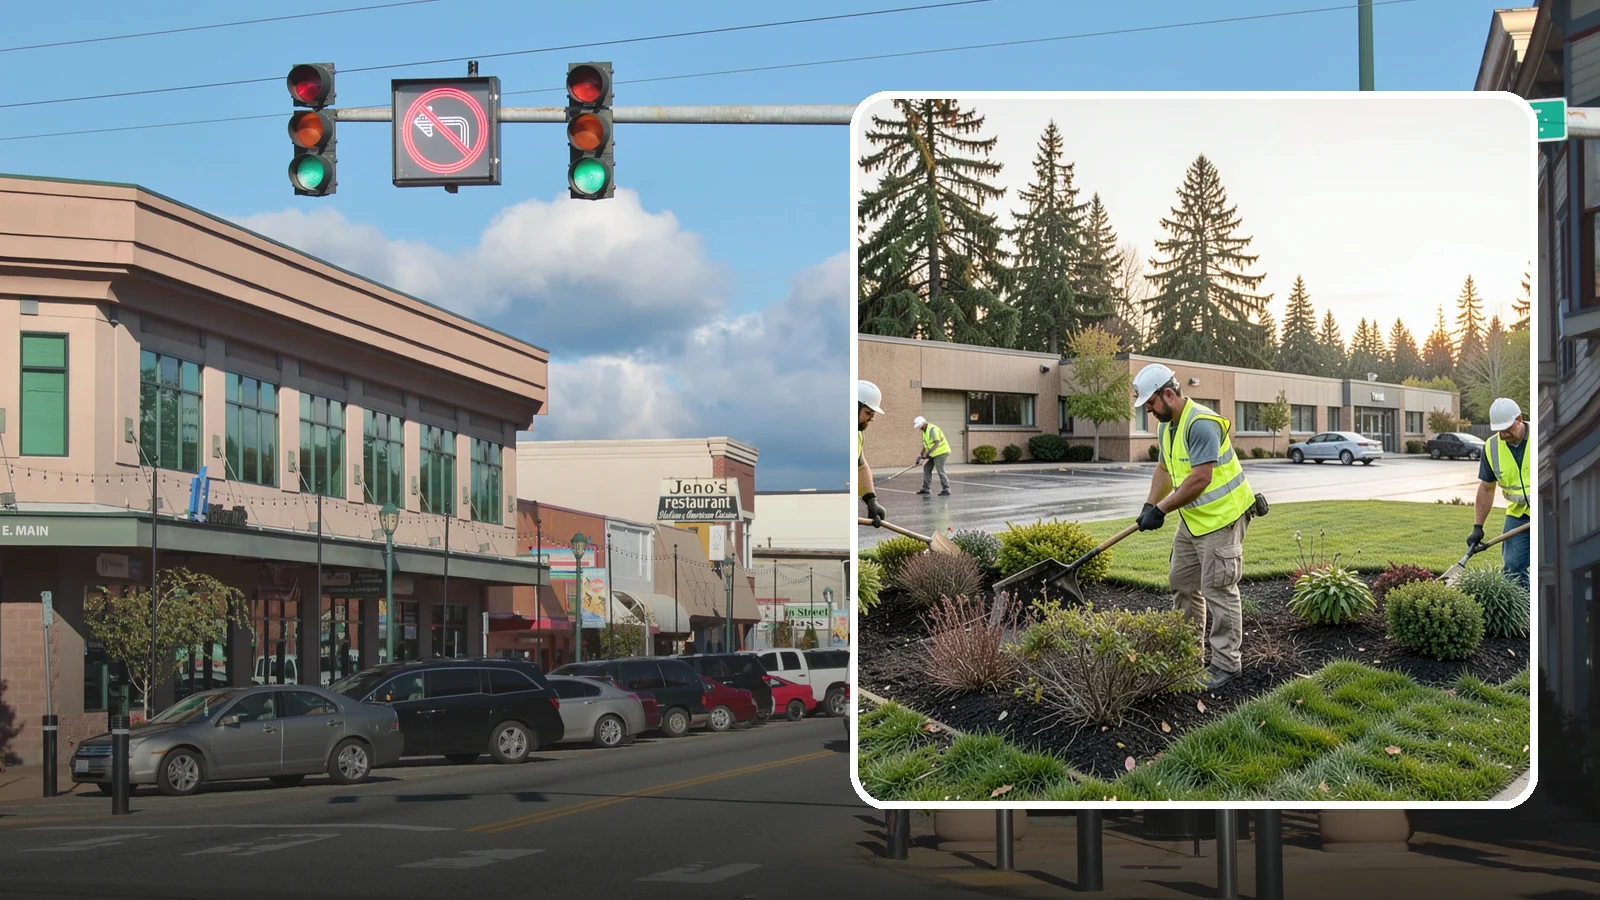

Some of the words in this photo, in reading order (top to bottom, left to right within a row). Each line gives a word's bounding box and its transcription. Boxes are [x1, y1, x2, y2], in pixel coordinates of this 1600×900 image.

[669, 480, 728, 494] Jeno's
[665, 496, 731, 509] restaurant
[658, 510, 682, 519] Italian
[686, 509, 714, 519] American
[715, 509, 737, 519] Cuisine
[2, 525, 13, 536] E.
[15, 525, 49, 536] MAIN
[786, 607, 795, 617] in
[797, 607, 828, 617] Street
[791, 619, 824, 627] lass
